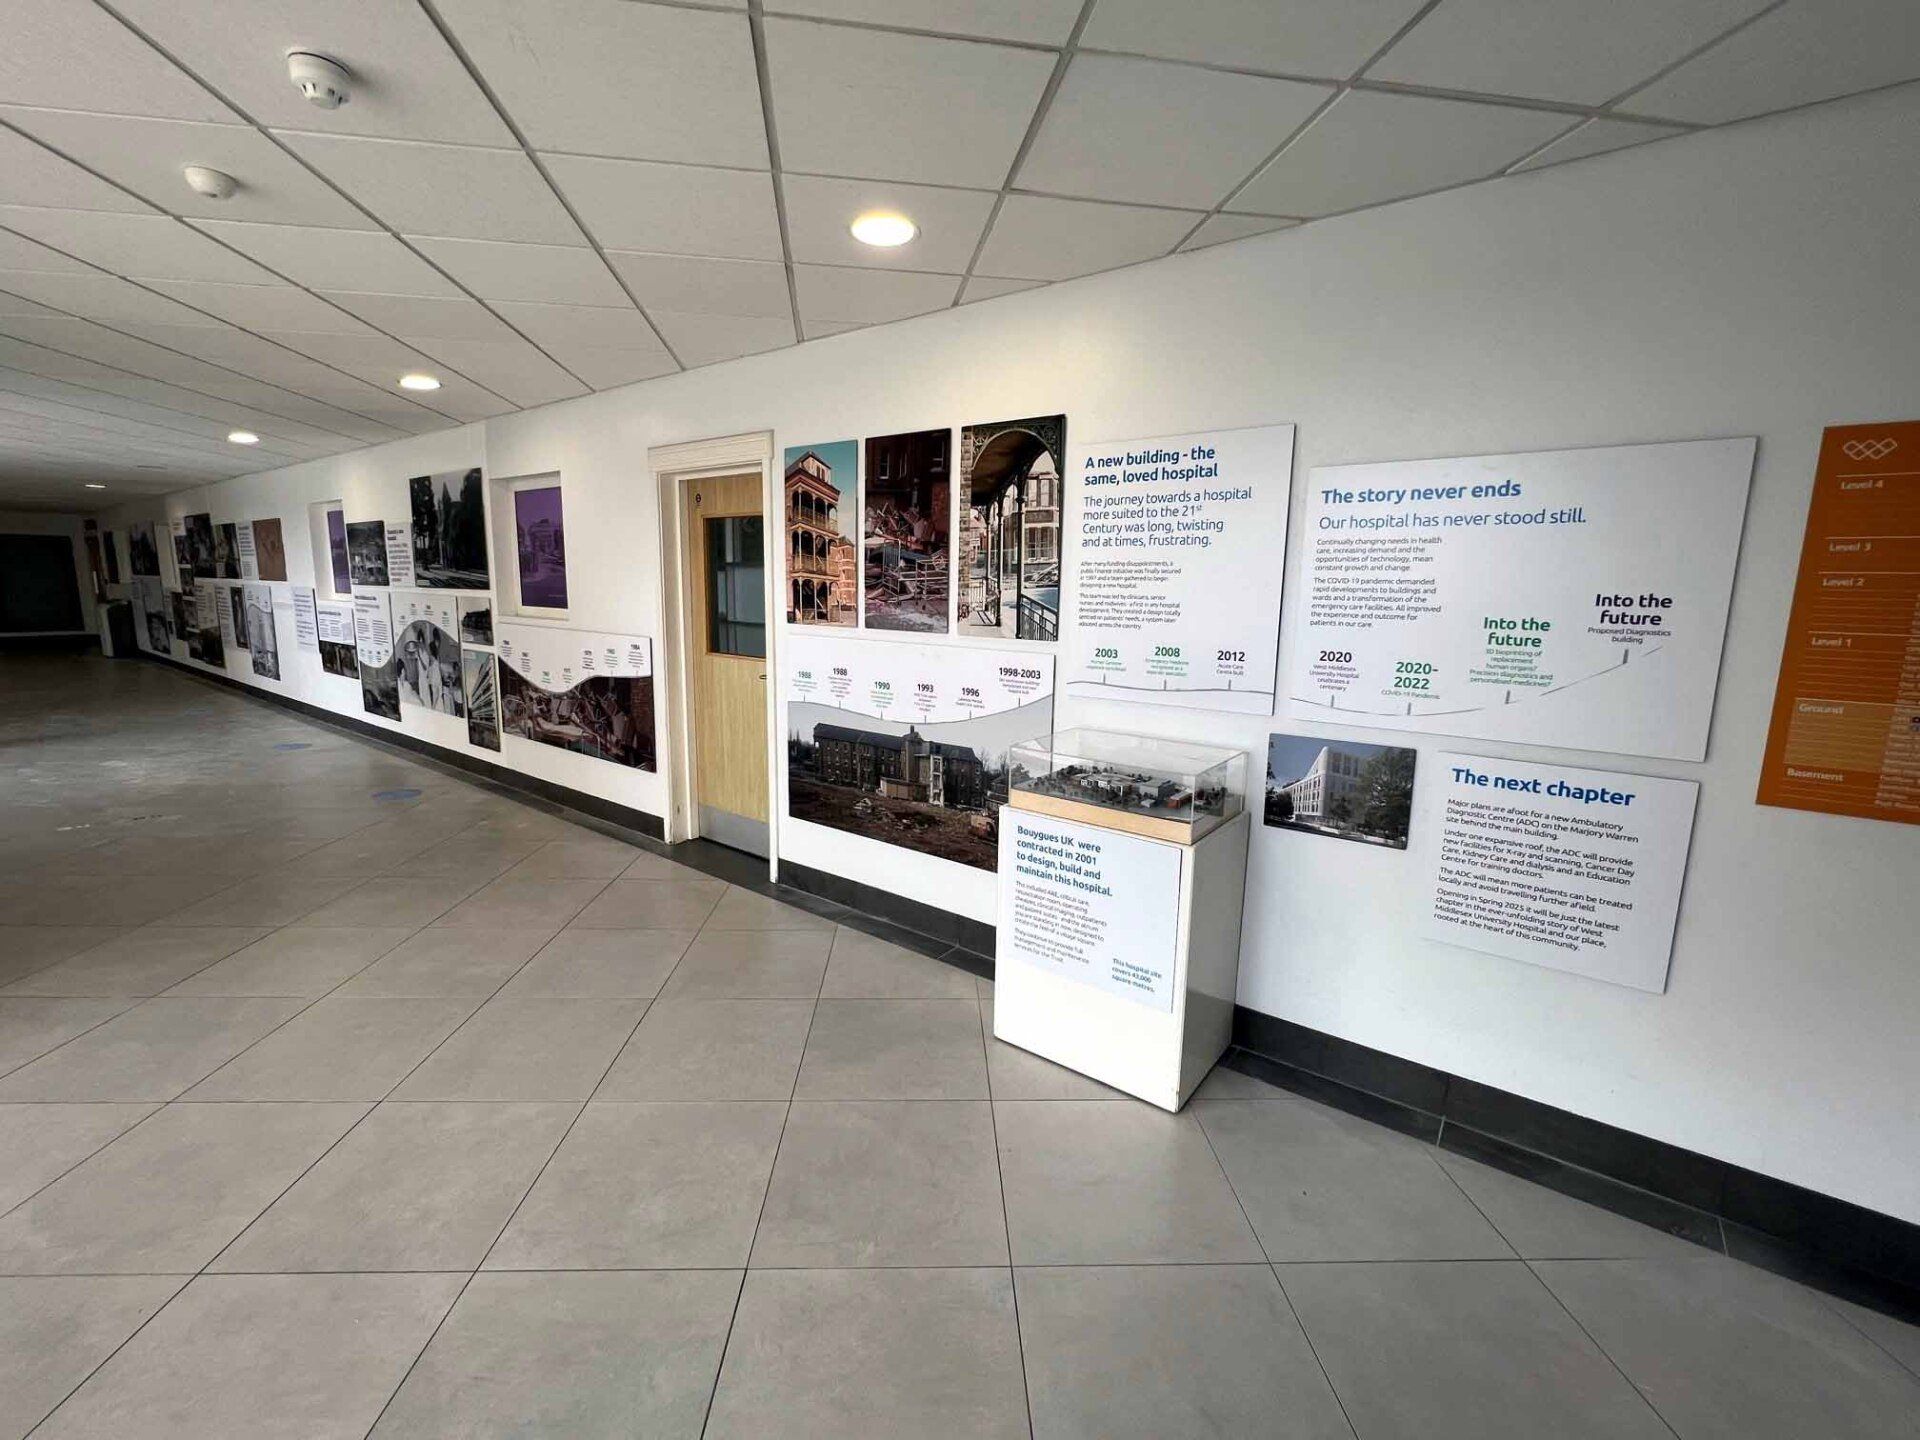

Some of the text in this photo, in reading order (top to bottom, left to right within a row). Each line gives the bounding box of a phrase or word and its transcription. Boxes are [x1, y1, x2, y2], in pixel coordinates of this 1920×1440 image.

[1085, 457, 1095, 469] A
[1097, 456, 1124, 468] new
[1126, 449, 1180, 466] building
[1191, 446, 1215, 460] the
[1084, 462, 1218, 486] same, loved hospital
[1321, 479, 1521, 505] The story never ends
[1841, 480, 1884, 490] Level 4
[1083, 486, 1252, 508] The journey towards a hospital
[1083, 504, 1202, 521] more suited to the 21st
[1319, 507, 1586, 531] Our hospital has never stood still.
[1082, 518, 1224, 536] Century was long, twisting
[1082, 533, 1212, 548] and at times, frustrating.
[1316, 537, 1354, 547] Continually
[1354, 538, 1387, 546] changing
[1387, 537, 1410, 546] needs
[1418, 536, 1443, 544] health
[1829, 542, 1860, 551] Level
[1332, 547, 1367, 555] increasing
[1367, 546, 1397, 554] demand
[1397, 545, 1412, 554] and
[1412, 545, 1426, 555] the
[1822, 578, 1853, 586] Level
[1595, 593, 1672, 608] Into the
[1484, 617, 1551, 632] Into the
[1600, 609, 1662, 626] future
[1587, 626, 1671, 637] Proposed Diagnostics
[1488, 632, 1542, 648] future
[1611, 635, 1644, 645] building
[1812, 637, 1842, 646] Level
[1095, 648, 1118, 659] 2003
[1154, 646, 1180, 658] 2008
[1217, 650, 1245, 662] 2012
[1319, 650, 1352, 663] 2020
[832, 668, 848, 676] 1988
[999, 667, 1041, 679] 1998-2003
[1396, 661, 1439, 675] 2020-
[874, 681, 891, 690] 1990
[917, 683, 934, 692] 1993
[1394, 676, 1430, 690] 2022
[961, 687, 980, 697] 1996
[1799, 703, 1844, 715] Ground
[1787, 767, 1843, 781] Basement
[1452, 768, 1636, 806] The next chapter
[1447, 798, 1470, 808] Major
[1470, 802, 1491, 811] plans
[1506, 807, 1529, 818] afoot
[1530, 810, 1544, 819] for
[1550, 814, 1571, 823] new
[1570, 816, 1624, 833] Ambulatory
[1445, 816, 1460, 824] site
[1460, 817, 1488, 828] behind
[1488, 822, 1502, 831] the
[1502, 825, 1523, 834] main
[1447, 807, 1487, 820] Diagnostic
[1487, 813, 1515, 824] Centre
[1515, 816, 1540, 829] (ADC)
[1553, 823, 1569, 832] the
[1570, 826, 1605, 839] Marjory
[1605, 831, 1639, 843] Warren
[1018, 825, 1101, 853] Bouygues UK were
[1016, 840, 1096, 866] contracted in 2001
[1444, 829, 1467, 838] Under
[1484, 836, 1524, 849] expansive
[1546, 846, 1560, 855] the
[1561, 848, 1581, 859] ADC
[1582, 853, 1598, 862] will
[1598, 855, 1633, 867] provide
[1017, 851, 1101, 880] to design, build and
[1441, 853, 1466, 865] Centre
[1468, 858, 1479, 867] for
[1480, 860, 1510, 874] training
[1443, 838, 1460, 846] new
[1460, 839, 1492, 852] facilities
[1492, 845, 1505, 855] for
[1527, 852, 1544, 862] and
[1585, 861, 1615, 873] Cancer
[1617, 866, 1635, 878] Day
[1462, 849, 1489, 861] Kidney
[1489, 854, 1508, 864] Care
[1509, 858, 1525, 867] and
[1525, 859, 1555, 872] dialysis
[1556, 867, 1573, 875] and
[1586, 871, 1631, 885] Education
[1016, 865, 1112, 897] maintain this hospital.
